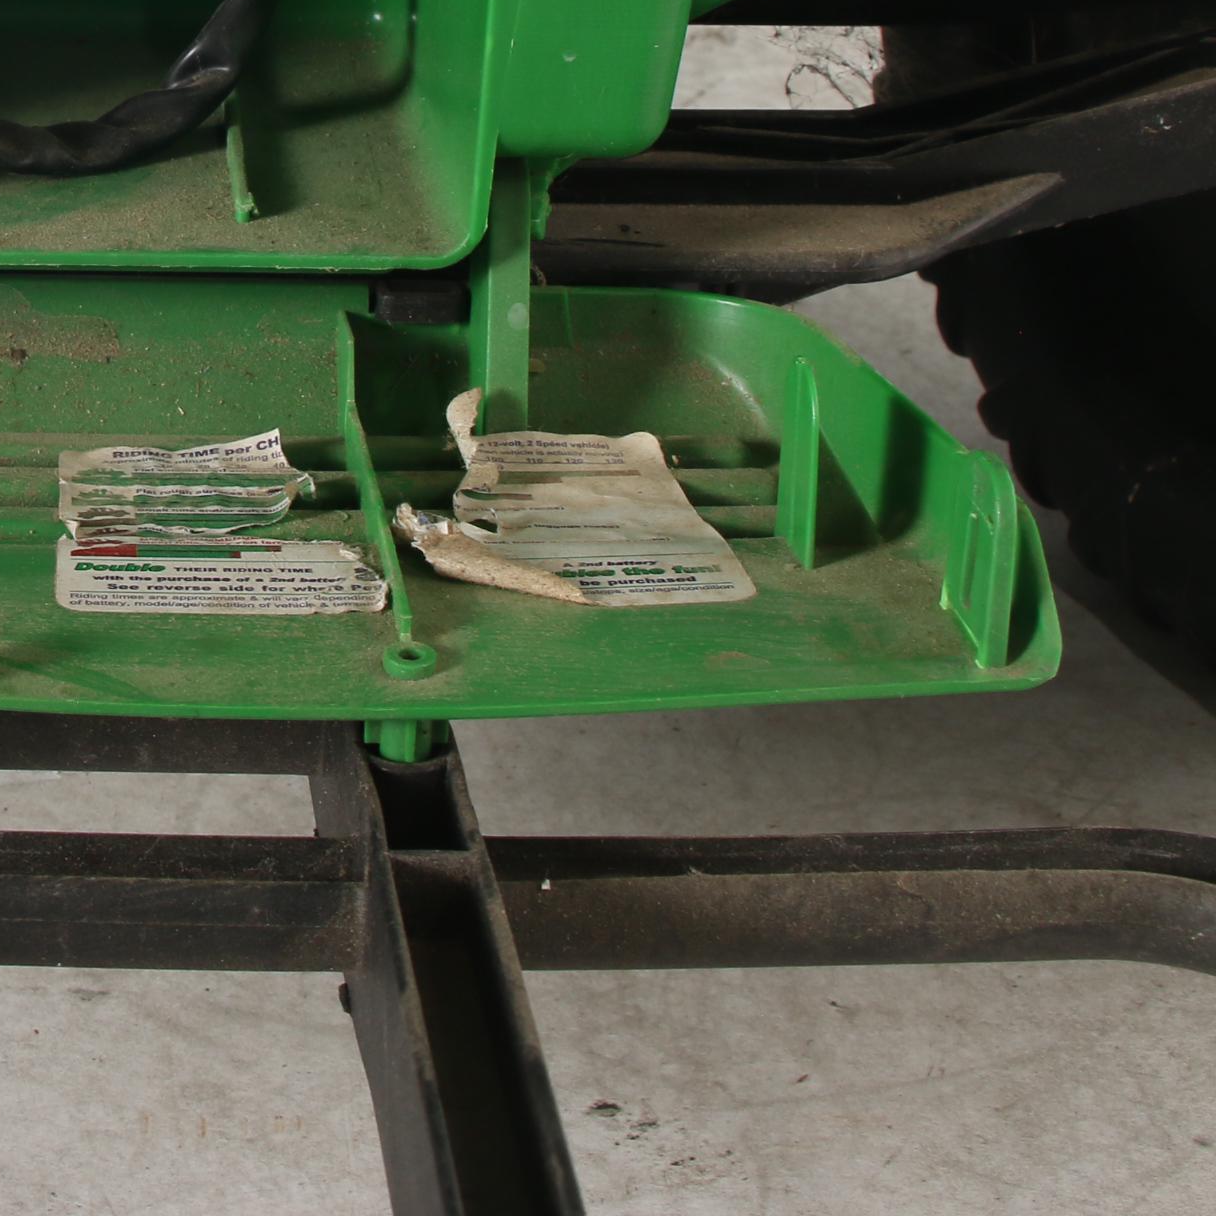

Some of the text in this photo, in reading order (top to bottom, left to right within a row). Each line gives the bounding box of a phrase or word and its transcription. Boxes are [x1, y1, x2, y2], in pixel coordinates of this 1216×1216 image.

[112, 450, 173, 459] RIDING
[177, 447, 220, 459] TIME
[224, 445, 252, 457] per
[236, 453, 269, 463] riding
[74, 562, 166, 572] Double
[622, 567, 665, 576] the
[608, 576, 696, 586] purchased
